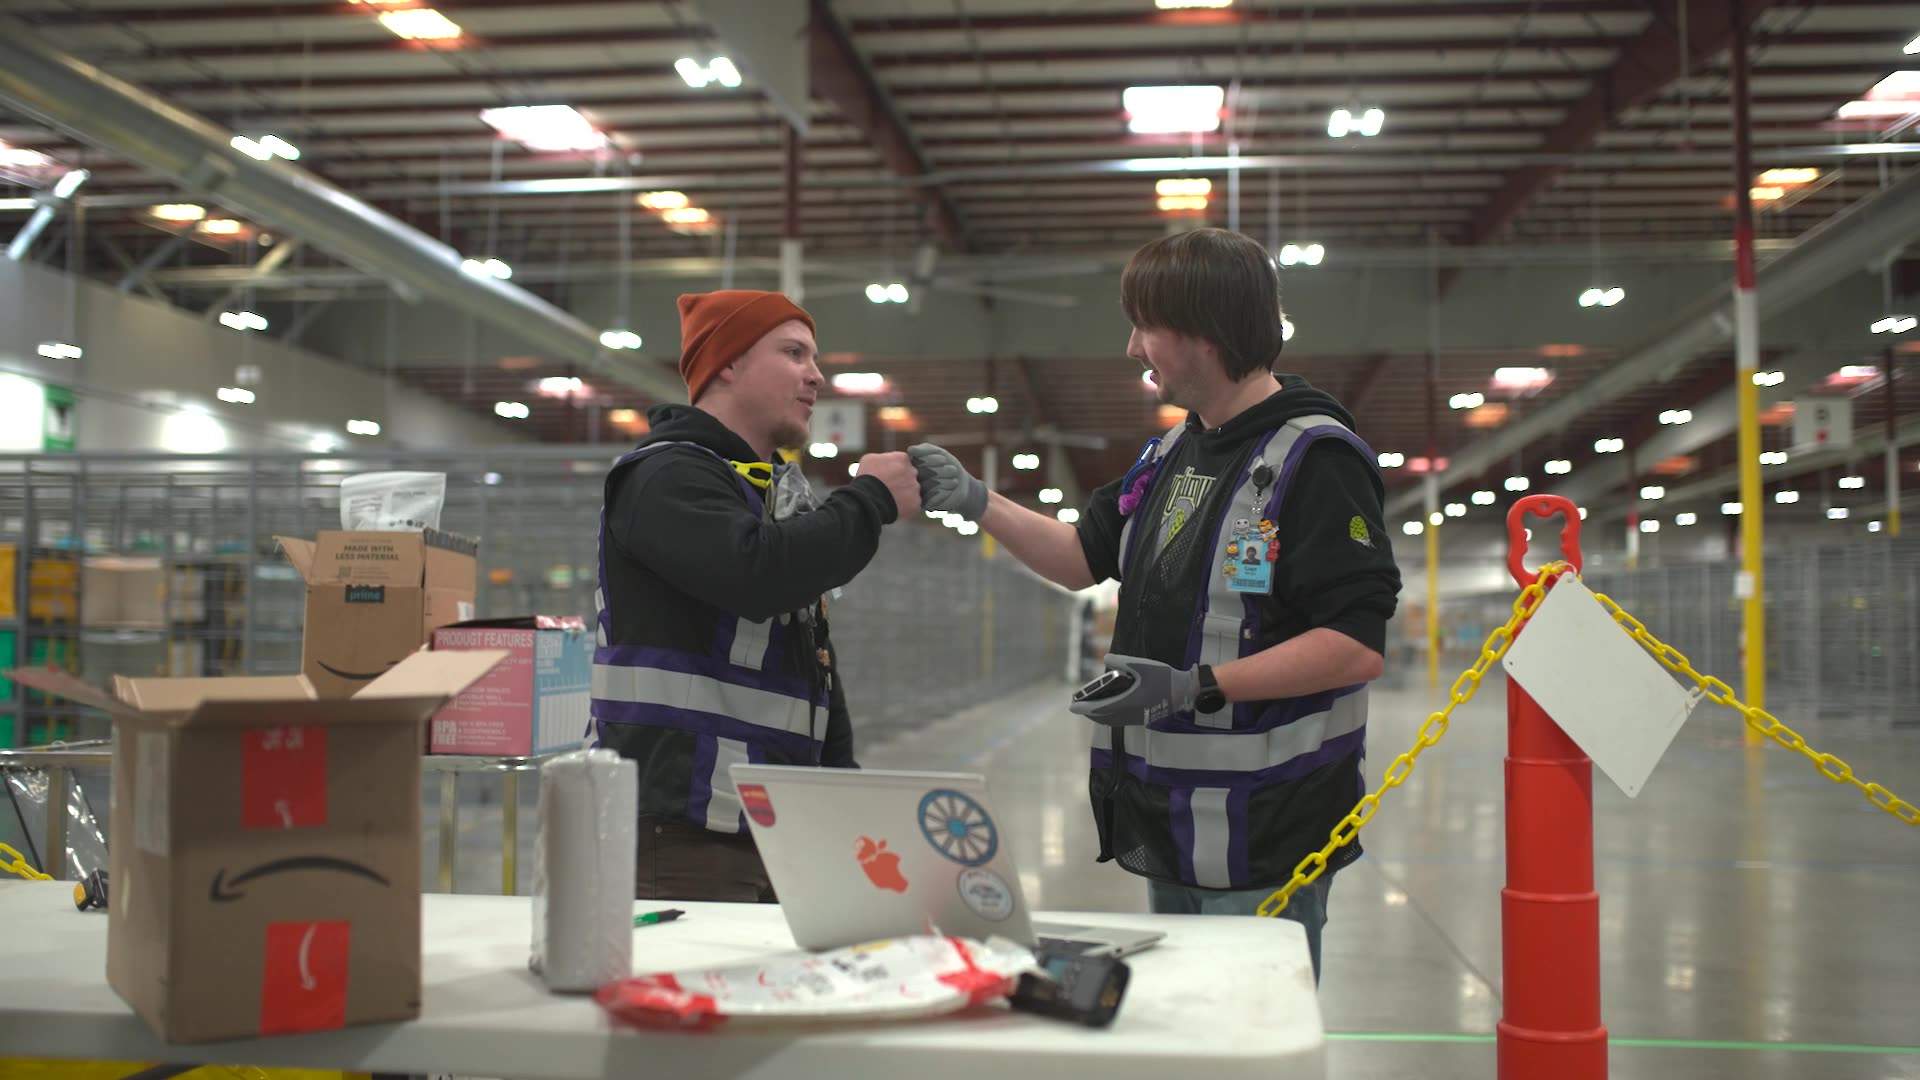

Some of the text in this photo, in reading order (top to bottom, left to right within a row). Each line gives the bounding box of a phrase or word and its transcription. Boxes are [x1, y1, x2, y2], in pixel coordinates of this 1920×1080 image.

[343, 545, 394, 553] MADE WITH
[335, 553, 400, 561] LESS MATERIAL
[349, 589, 381, 601] prime
[484, 632, 534, 648] FEATURES
[433, 720, 457, 733] BPA
[433, 734, 457, 745] FREE
